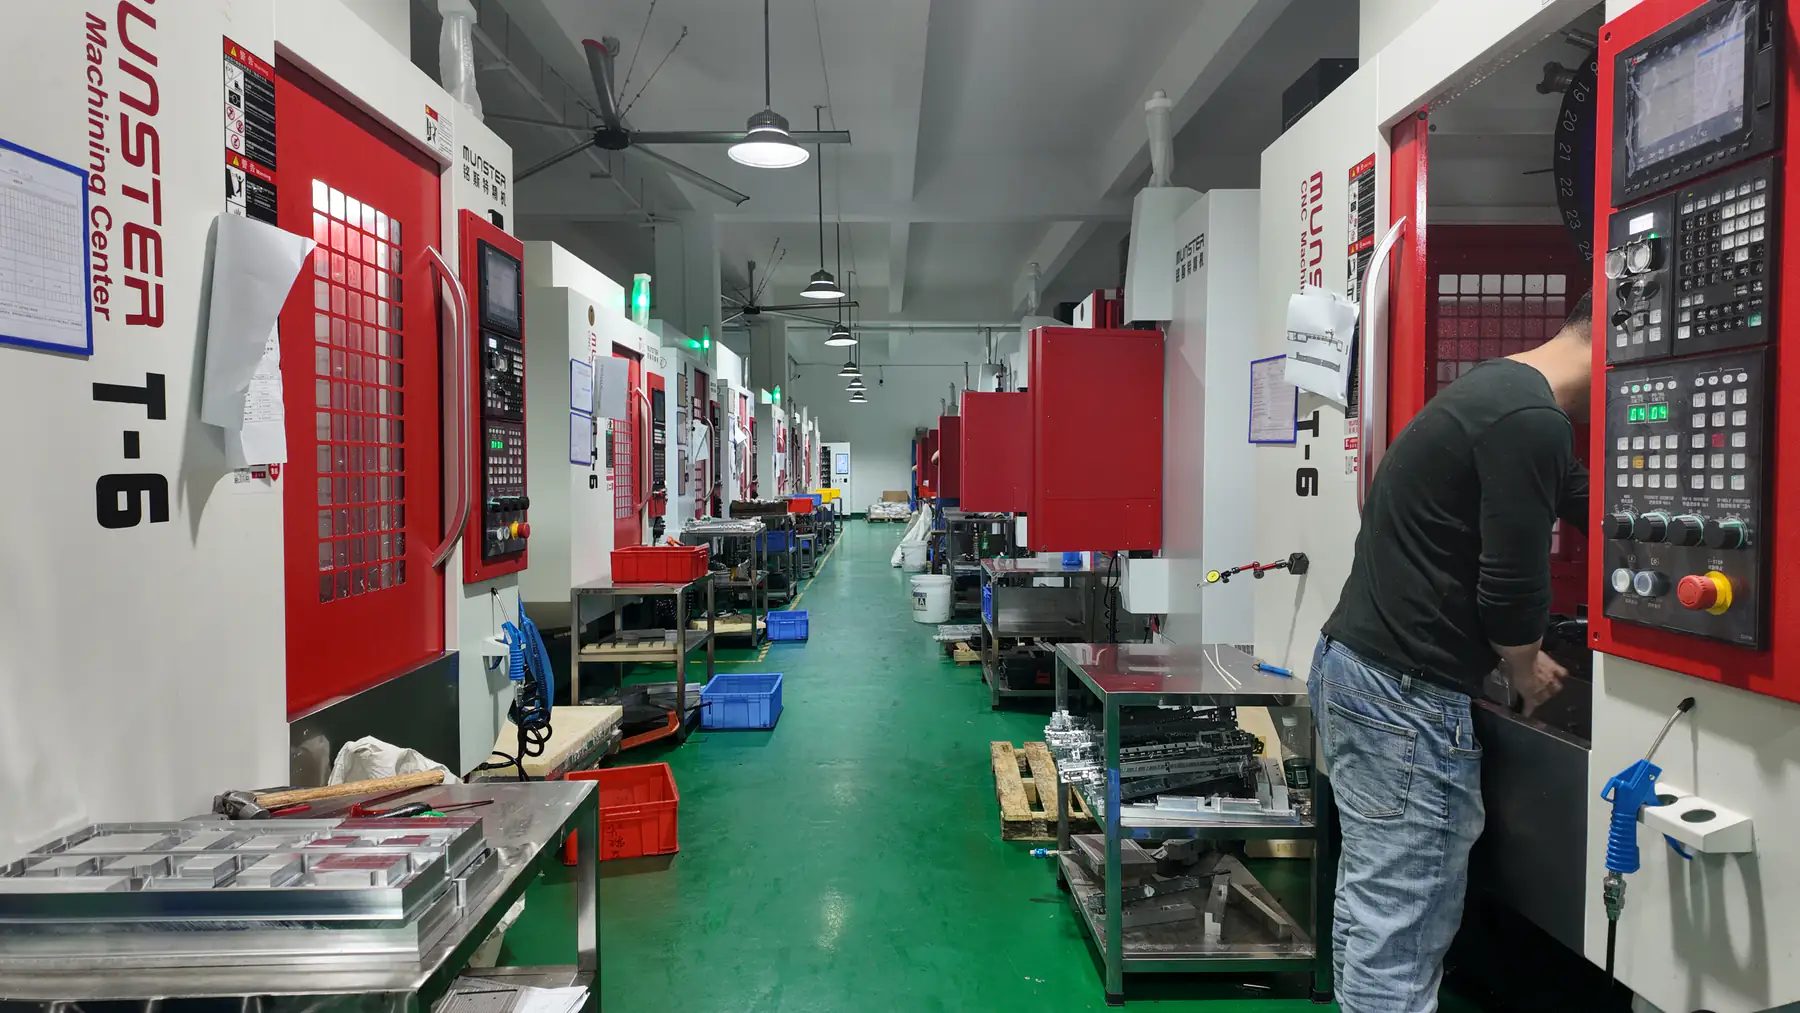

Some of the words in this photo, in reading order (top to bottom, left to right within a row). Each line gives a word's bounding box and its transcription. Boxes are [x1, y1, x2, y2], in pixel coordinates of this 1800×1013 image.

[85, 11, 110, 196] Machining
[1573, 81, 1590, 102] 19
[1563, 109, 1578, 132] 20
[117, 0, 164, 328] UNSTER
[463, 144, 506, 190] MUNSTER
[1559, 142, 1572, 161] 21
[1300, 180, 1308, 221] CNC
[1560, 177, 1573, 197] 22
[1309, 171, 1323, 288] MUNS
[1566, 209, 1581, 229] 23
[90, 205, 114, 322] Center
[1578, 240, 1593, 261] 24
[1651, 405, 1666, 420] 04
[93, 372, 169, 529] T-6
[1296, 410, 1319, 497] T-6
